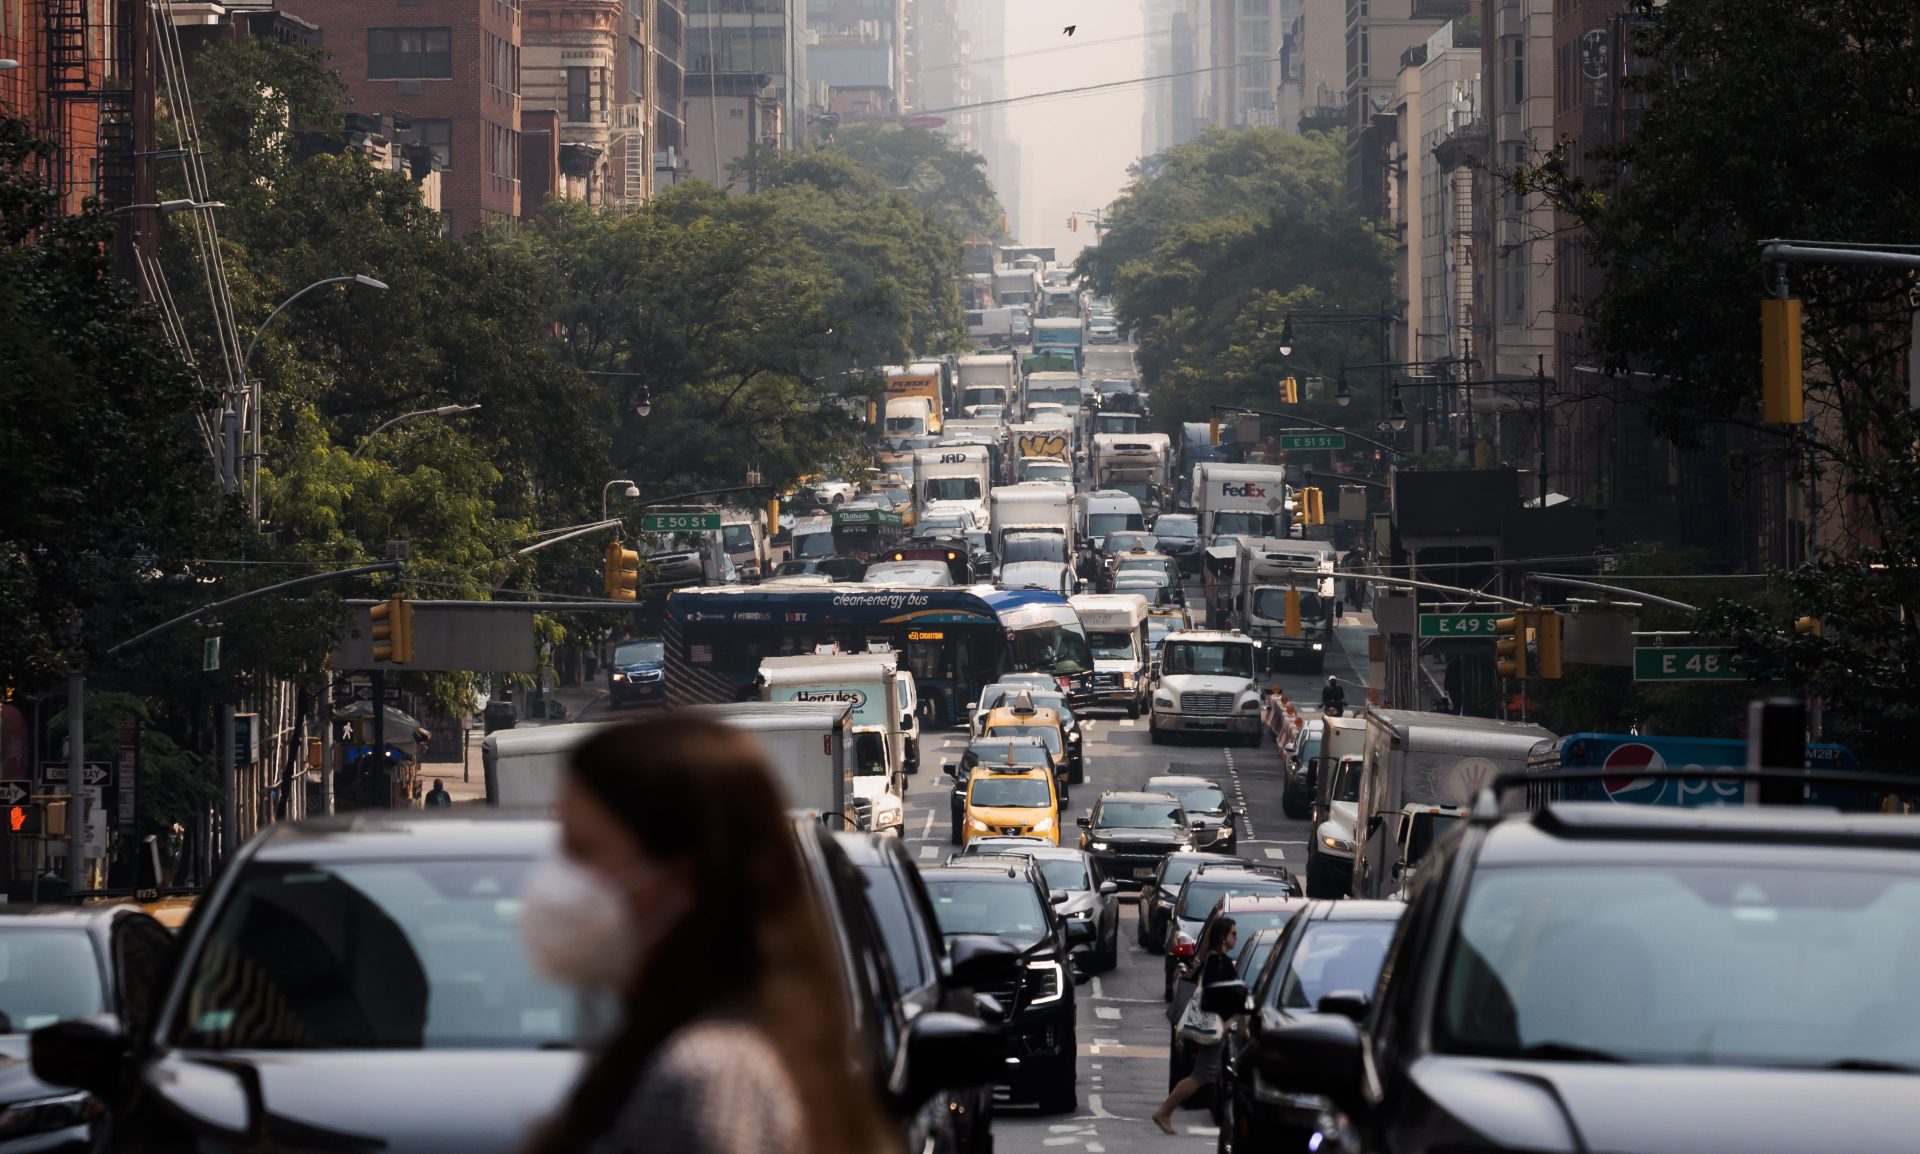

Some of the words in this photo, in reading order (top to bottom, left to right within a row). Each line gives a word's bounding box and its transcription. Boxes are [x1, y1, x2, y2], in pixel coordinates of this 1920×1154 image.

[1294, 438, 1301, 447] E
[1304, 438, 1316, 446] 51
[1319, 437, 1332, 446] St
[1222, 482, 1266, 498] FedEx
[657, 517, 665, 528] E
[669, 517, 687, 527] 50
[691, 517, 706, 527] St
[833, 593, 906, 609] clean-energy
[907, 593, 929, 605] bus
[1440, 619, 1449, 632] E
[1455, 618, 1480, 632] 49
[1487, 619, 1497, 632] S
[1663, 654, 1677, 673] E
[1685, 654, 1720, 673] 48
